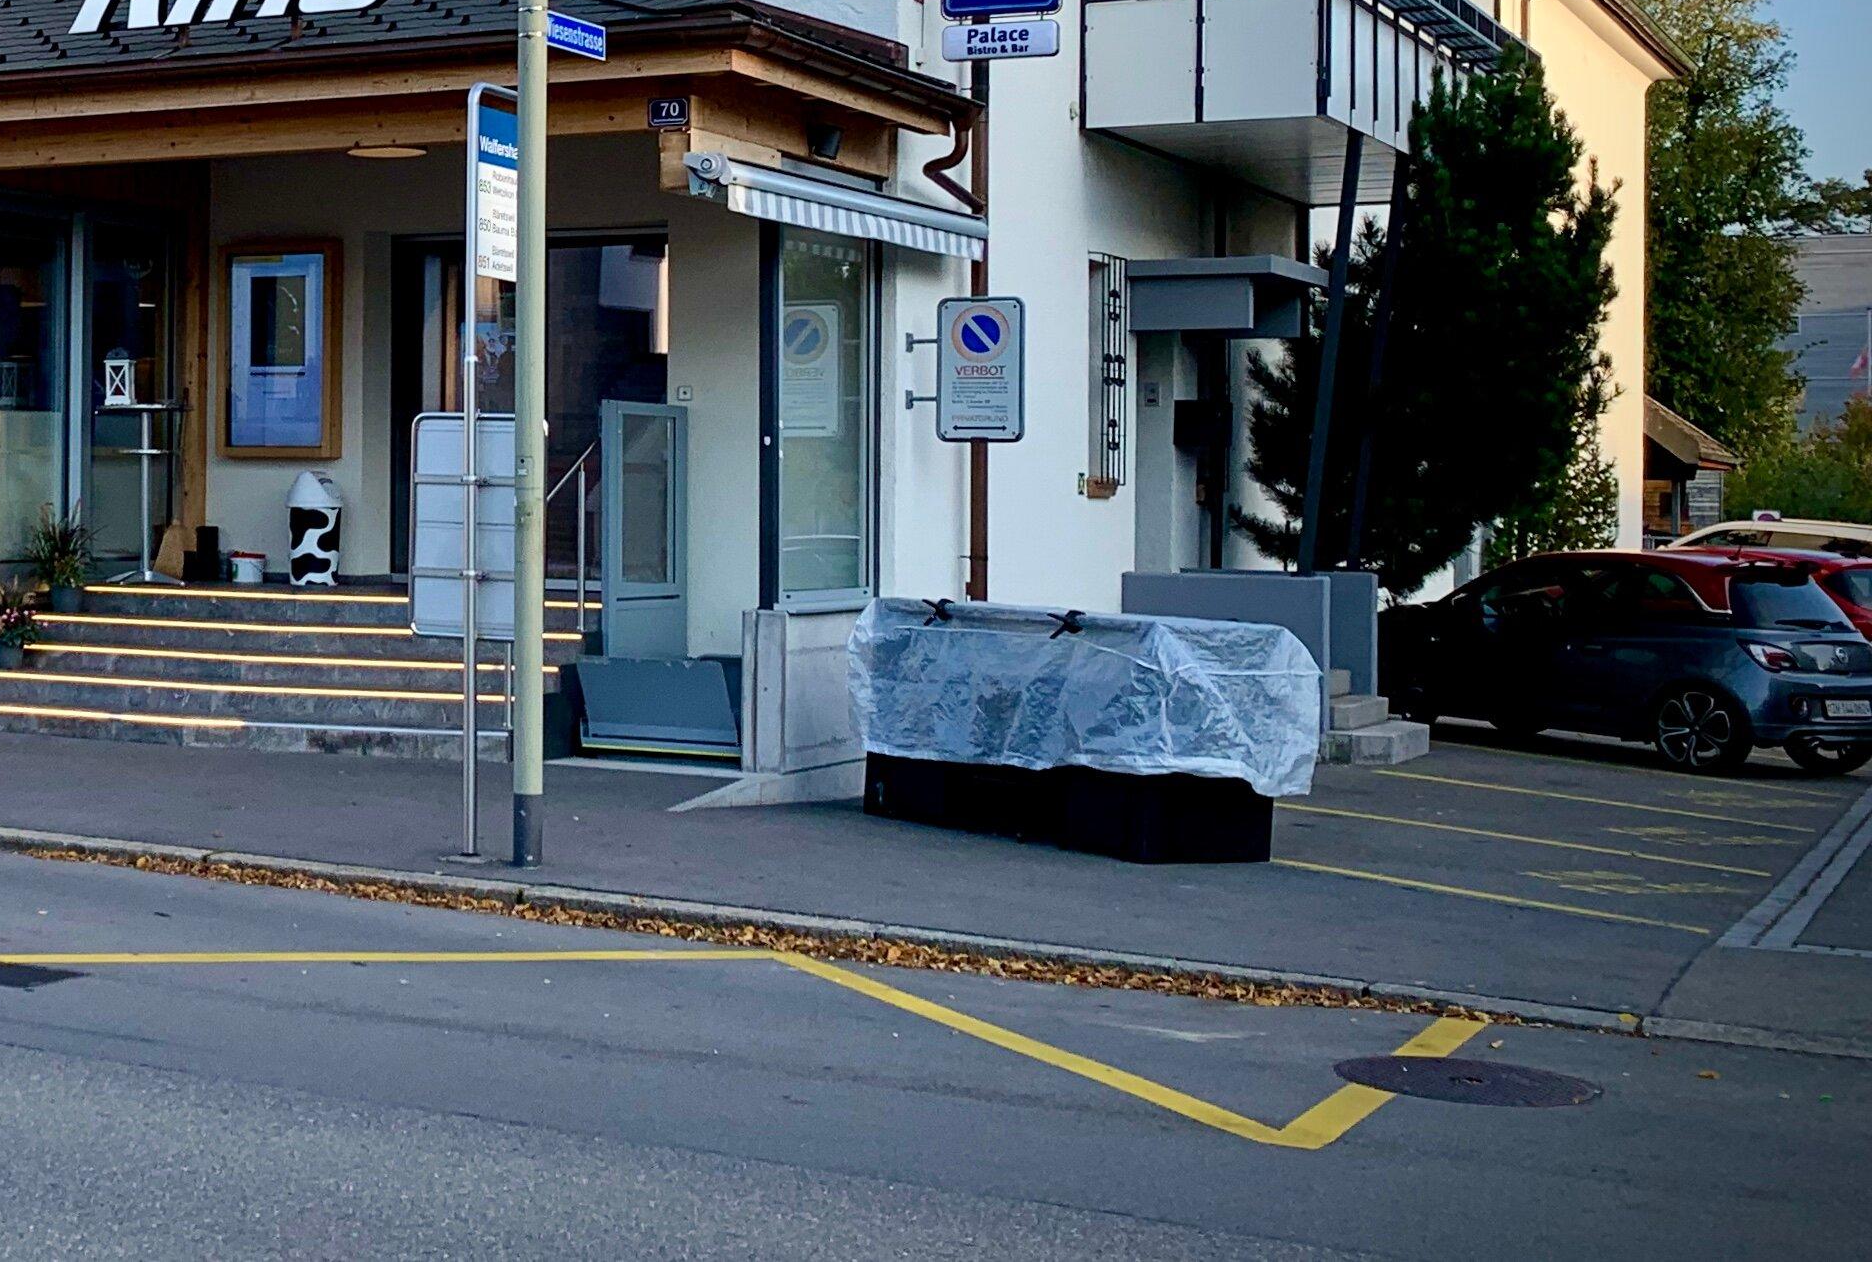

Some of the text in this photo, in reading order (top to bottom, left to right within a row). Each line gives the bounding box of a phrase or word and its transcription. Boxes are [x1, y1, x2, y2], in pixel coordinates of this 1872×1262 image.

[966, 27, 1030, 45] Palace
[966, 44, 1029, 56] Bistro & Bar
[660, 102, 680, 117] 70
[479, 217, 492, 233] 850
[954, 365, 1006, 376] VERBOT
